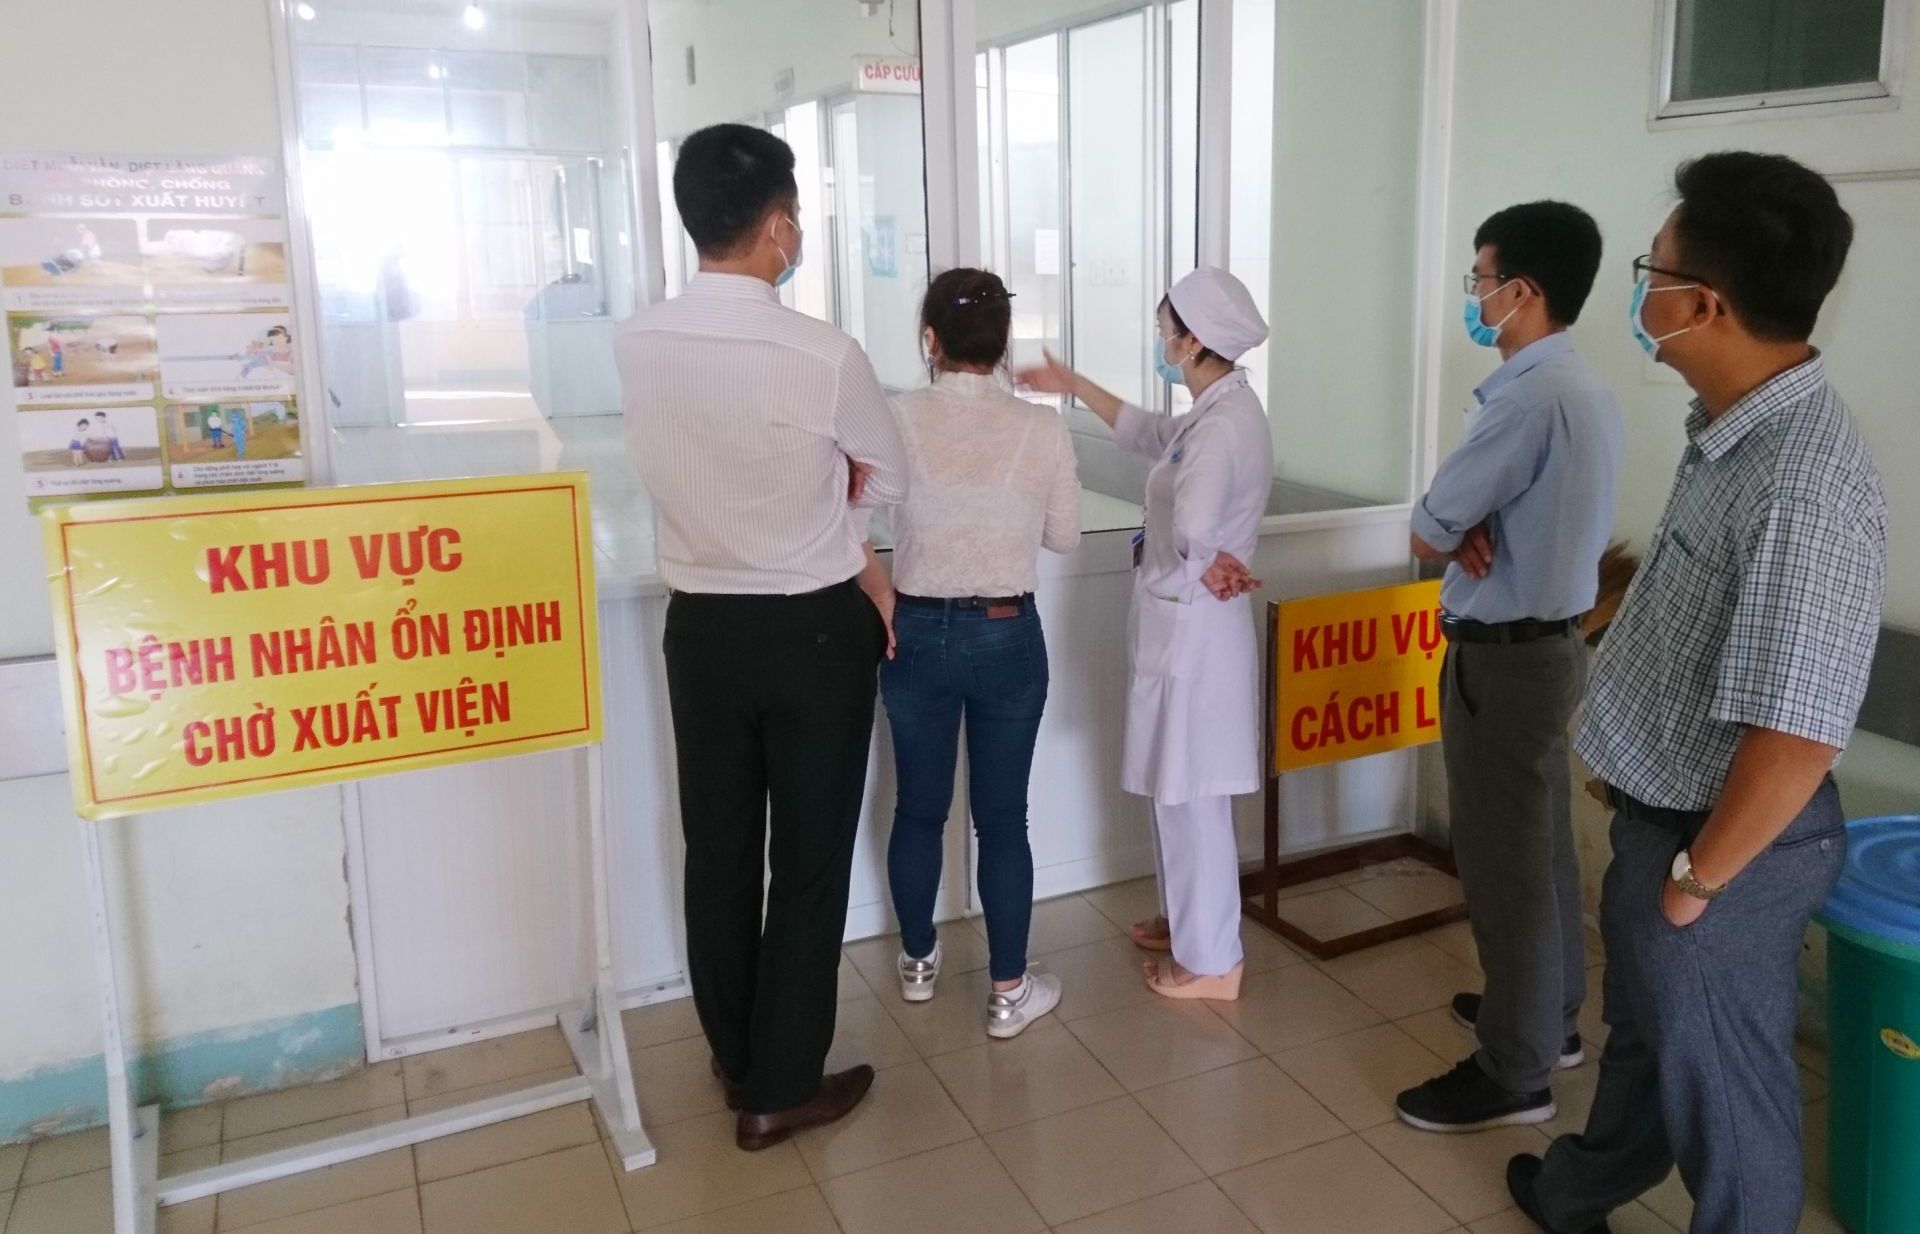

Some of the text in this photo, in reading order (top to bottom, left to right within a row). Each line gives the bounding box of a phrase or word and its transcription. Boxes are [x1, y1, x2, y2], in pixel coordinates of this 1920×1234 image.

[131, 190, 188, 208] XUẤT
[206, 524, 463, 593] KHU VỰC
[106, 598, 562, 702] BỆNH NHÂN ỔN ĐỊNH
[1293, 608, 1442, 673] KHU VỰ
[183, 676, 511, 767] CHỜ XUẤT VIỆN
[1291, 686, 1436, 751] CÁCH L
